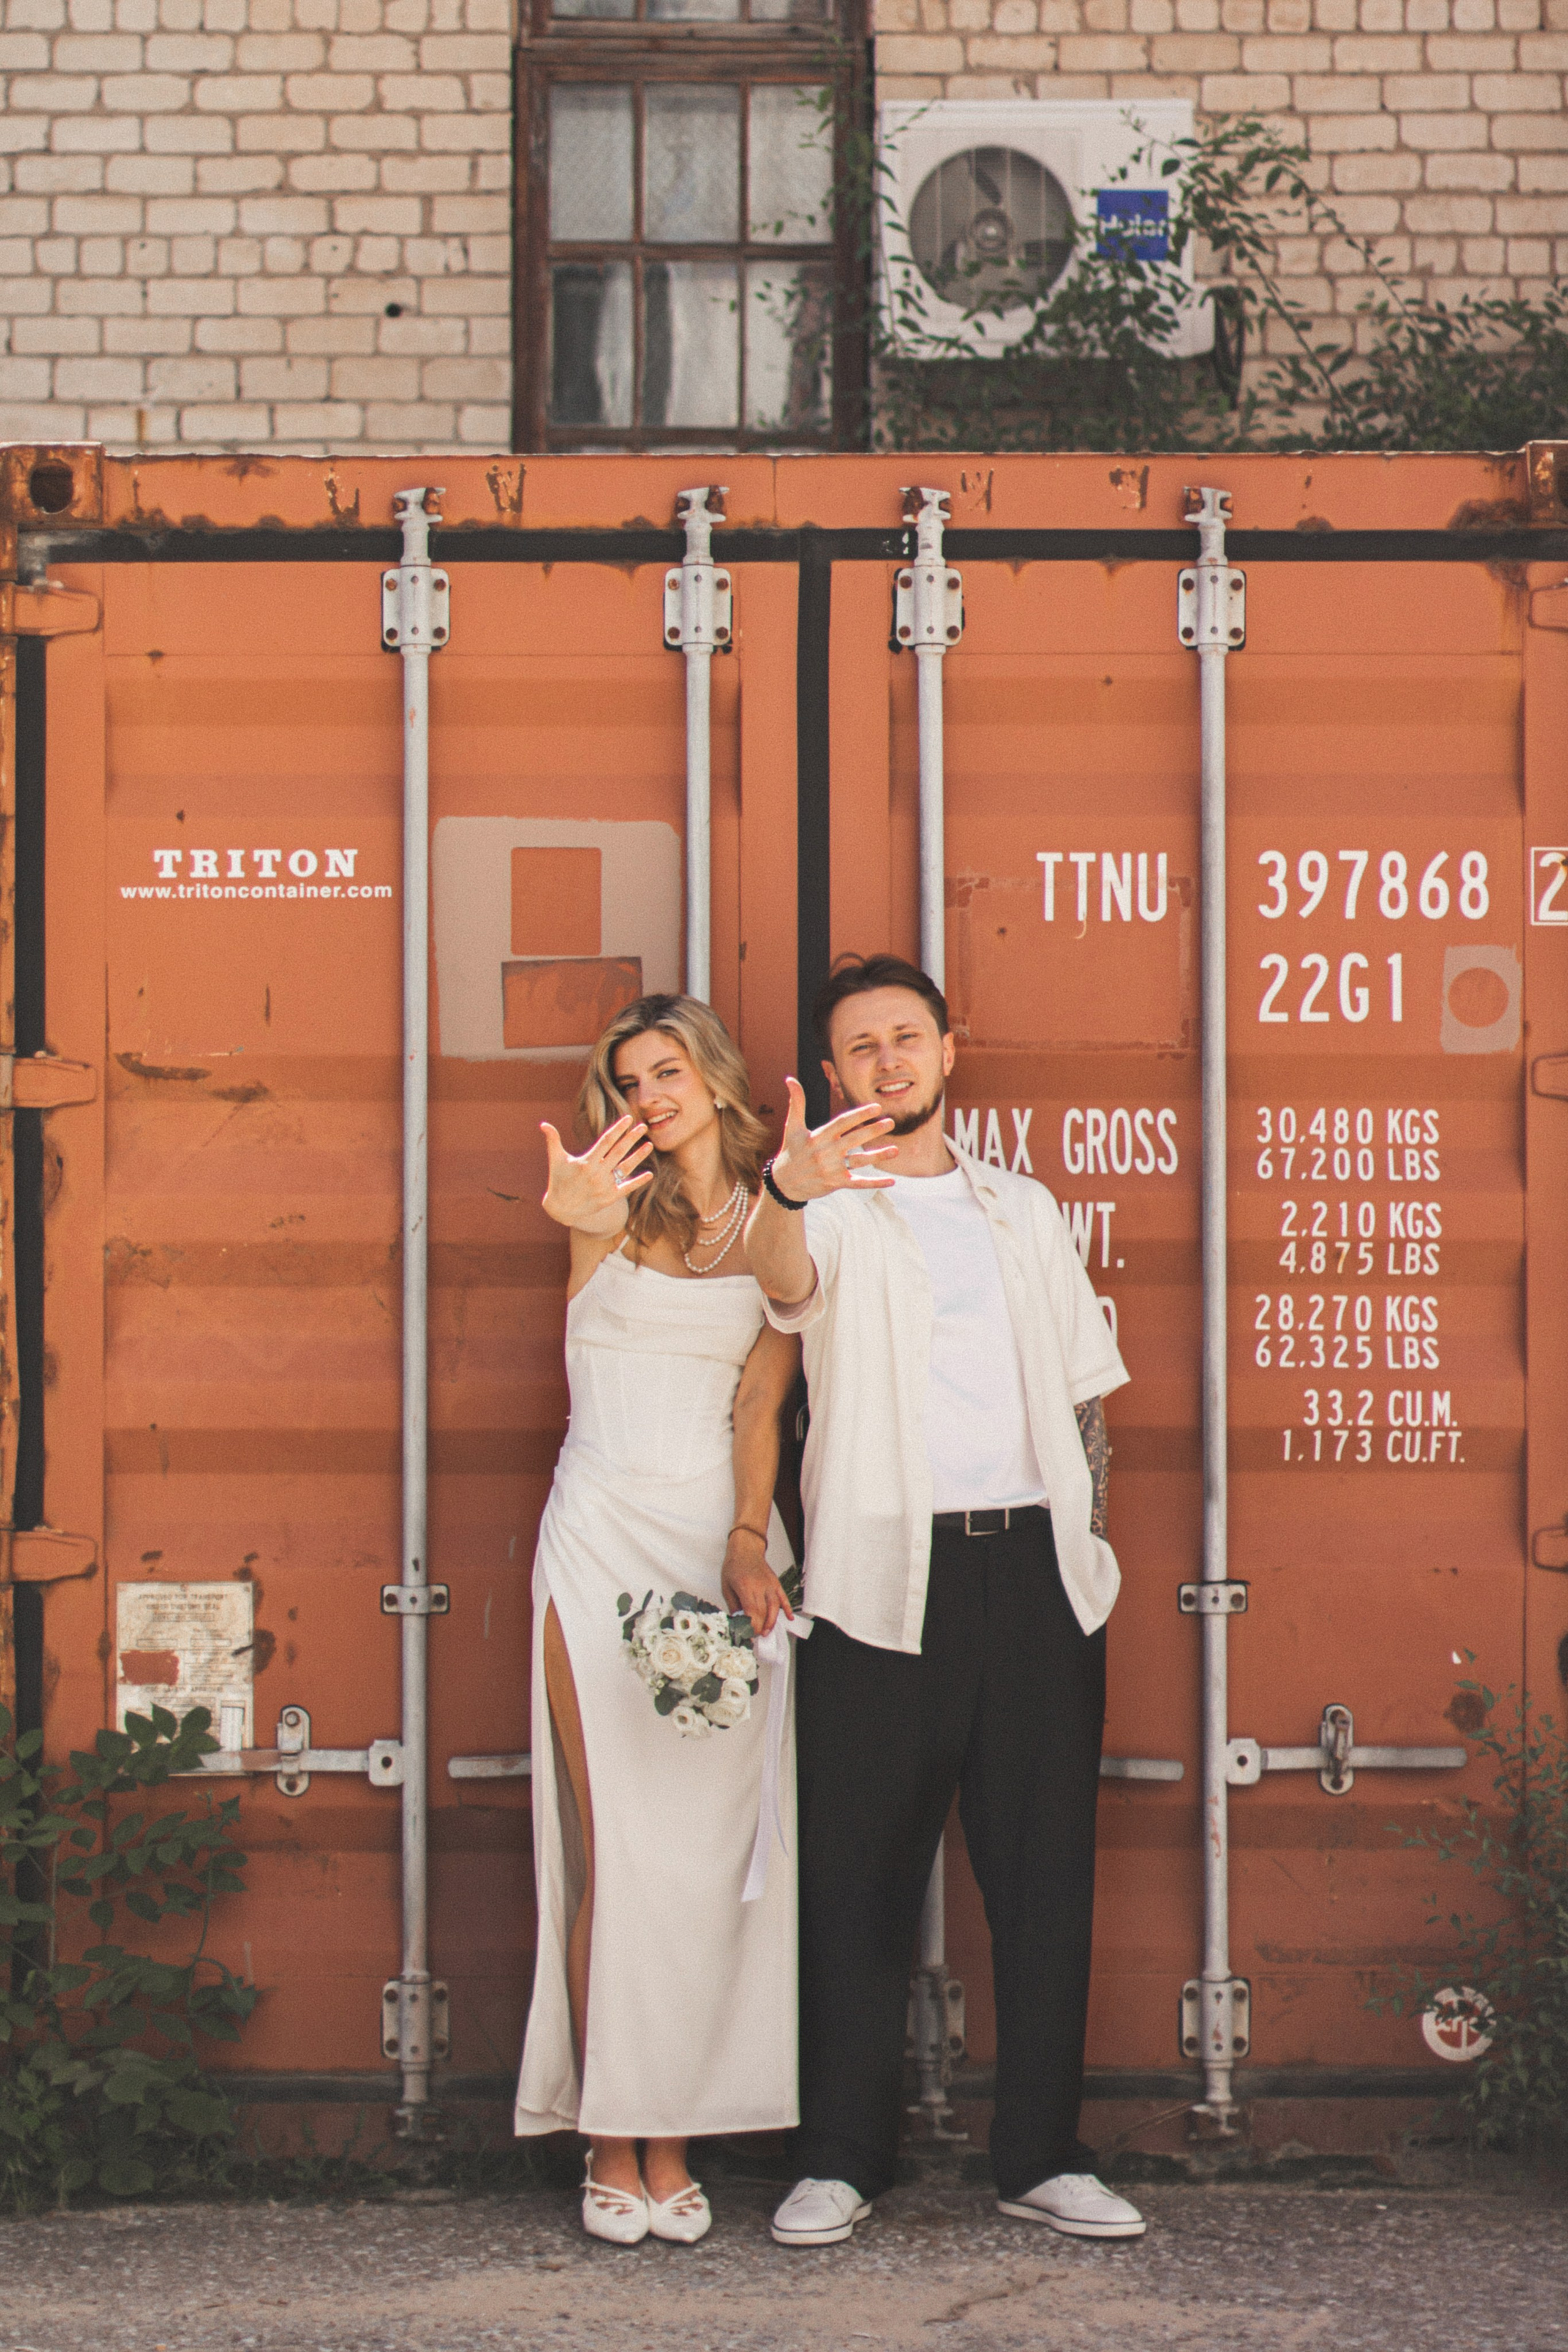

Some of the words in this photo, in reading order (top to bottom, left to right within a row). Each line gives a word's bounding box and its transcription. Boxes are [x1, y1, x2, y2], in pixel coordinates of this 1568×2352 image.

[153, 849, 358, 878] TRITON
[121, 883, 393, 899] www.tritoncontainer.com
[1036, 852, 1167, 922] TTNU
[1258, 850, 1489, 919] 397868
[1538, 852, 1568, 921] 2
[1258, 952, 1402, 1022] 22G1
[954, 1108, 1033, 1174] MAX
[1063, 1108, 1178, 1174] GROSS
[1257, 1107, 1373, 1144] 30,480
[1387, 1109, 1439, 1145] KGS
[1257, 1148, 1374, 1181] 67,200
[1387, 1148, 1440, 1182] LBS
[1281, 1200, 1375, 1237] 2,210
[1389, 1202, 1442, 1239] KGS
[1279, 1242, 1373, 1275] 4,875
[1387, 1243, 1439, 1275] LBS
[1254, 1294, 1372, 1332] 28,270
[1385, 1295, 1438, 1332] KGS
[1255, 1335, 1372, 1369] 62,325
[1386, 1336, 1439, 1369] LBS
[1303, 1389, 1373, 1426] 33.2
[1388, 1390, 1458, 1427] CU.M.
[1284, 1430, 1371, 1461] 1,173
[1387, 1431, 1464, 1463] CU.FT.
